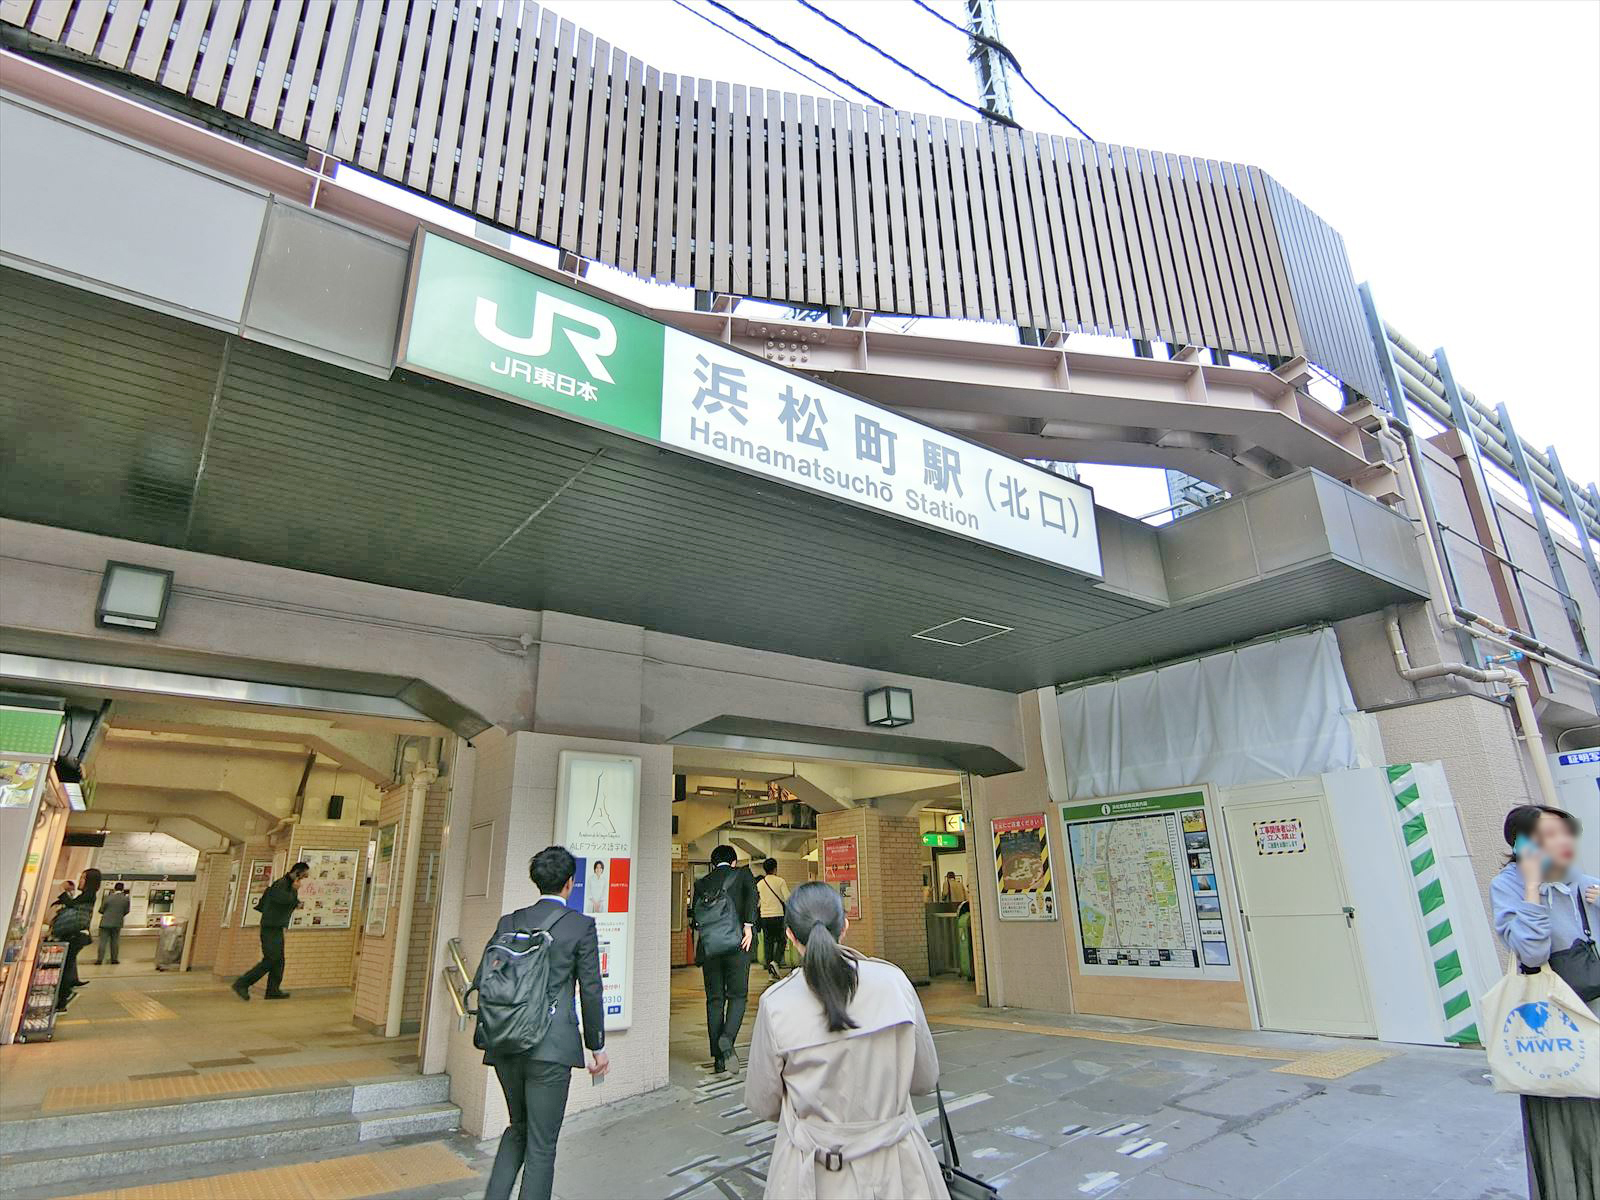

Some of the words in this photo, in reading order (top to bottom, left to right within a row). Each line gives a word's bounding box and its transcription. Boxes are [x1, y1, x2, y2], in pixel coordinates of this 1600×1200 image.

[474, 291, 617, 385] JR
[490, 356, 598, 402] JR東日本
[690, 416, 893, 502] Hamamatsuchō
[906, 488, 979, 530] Station
[994, 819, 1042, 829] にご注意ください!
[1516, 1038, 1574, 1053] MWR
